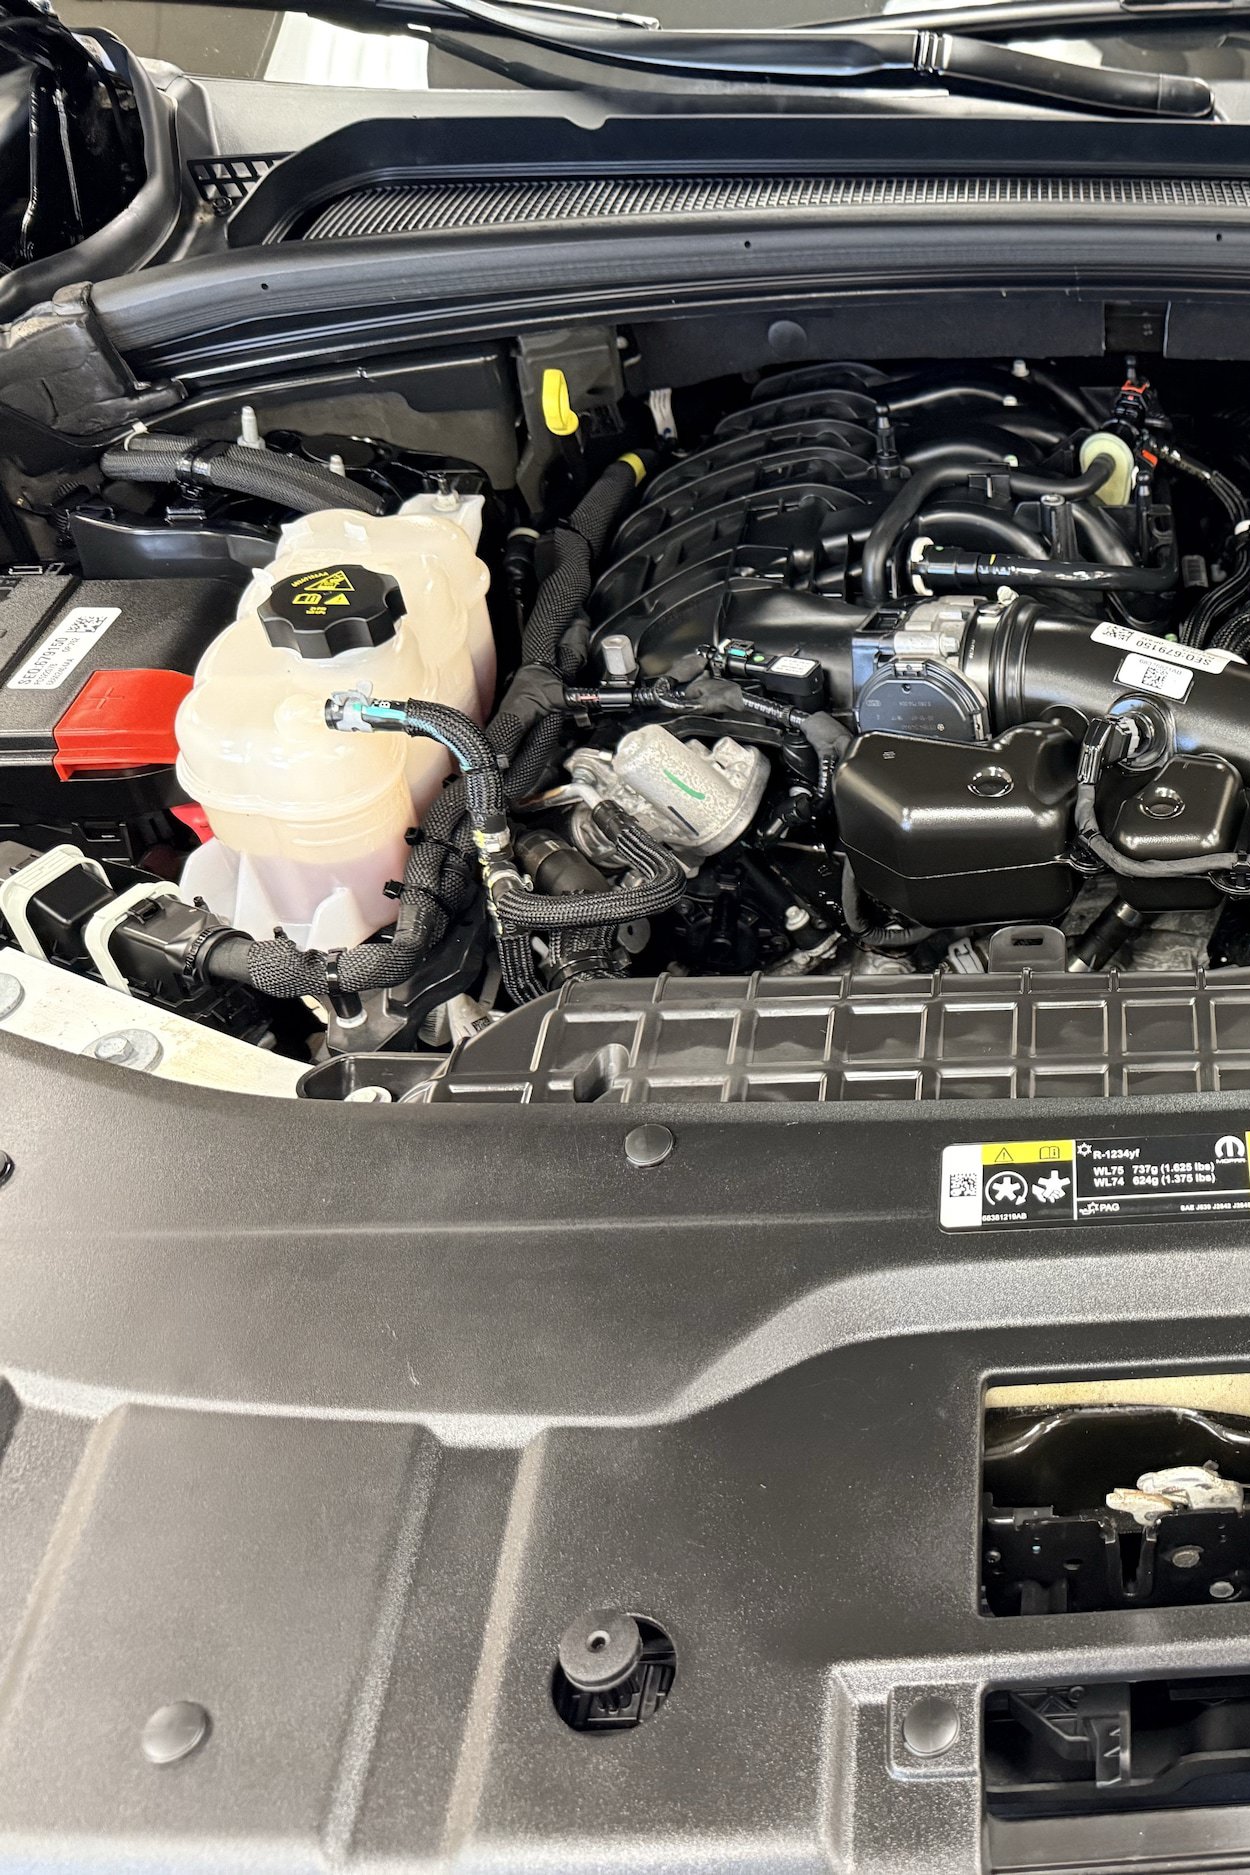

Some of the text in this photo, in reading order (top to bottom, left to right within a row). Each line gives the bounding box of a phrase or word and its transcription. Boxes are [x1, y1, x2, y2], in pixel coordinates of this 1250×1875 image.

[1135, 640, 1212, 666] SEQ:679150
[1093, 1148, 1140, 1160] R-1234yf
[1093, 1161, 1215, 1177] WL75 737g (1.625 lbs)
[1093, 1172, 1216, 1187] WL74 624g (1.375 lbs)
[1100, 1203, 1120, 1212] PAG
